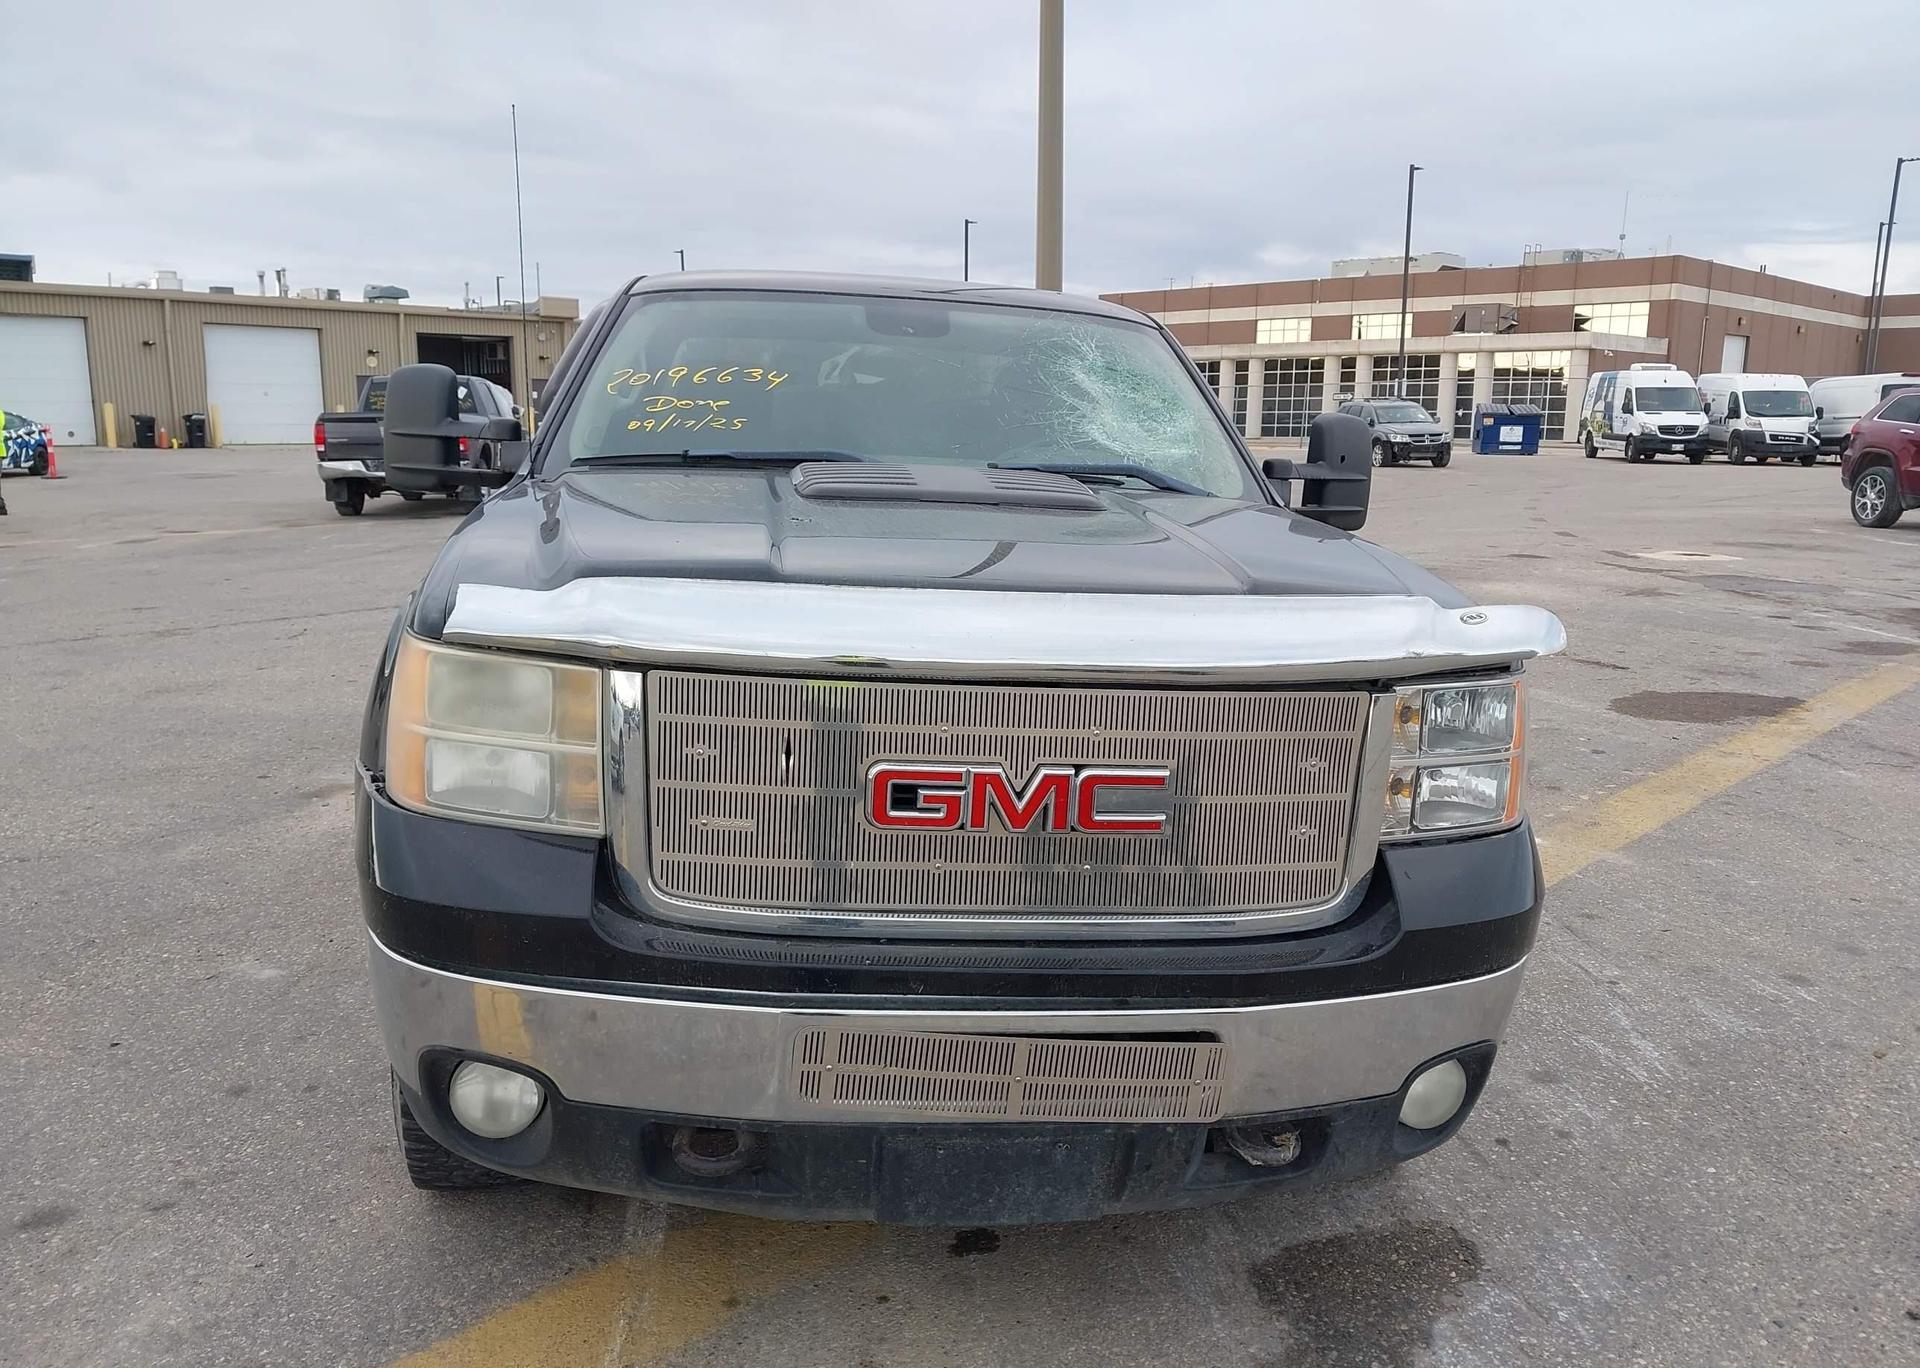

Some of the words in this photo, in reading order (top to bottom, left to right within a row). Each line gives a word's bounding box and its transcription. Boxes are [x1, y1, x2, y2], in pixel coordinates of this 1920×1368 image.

[607, 366, 789, 395] 20196634
[643, 396, 731, 412] Done
[626, 413, 748, 433] 09/17/25
[865, 758, 1171, 834] GMC
